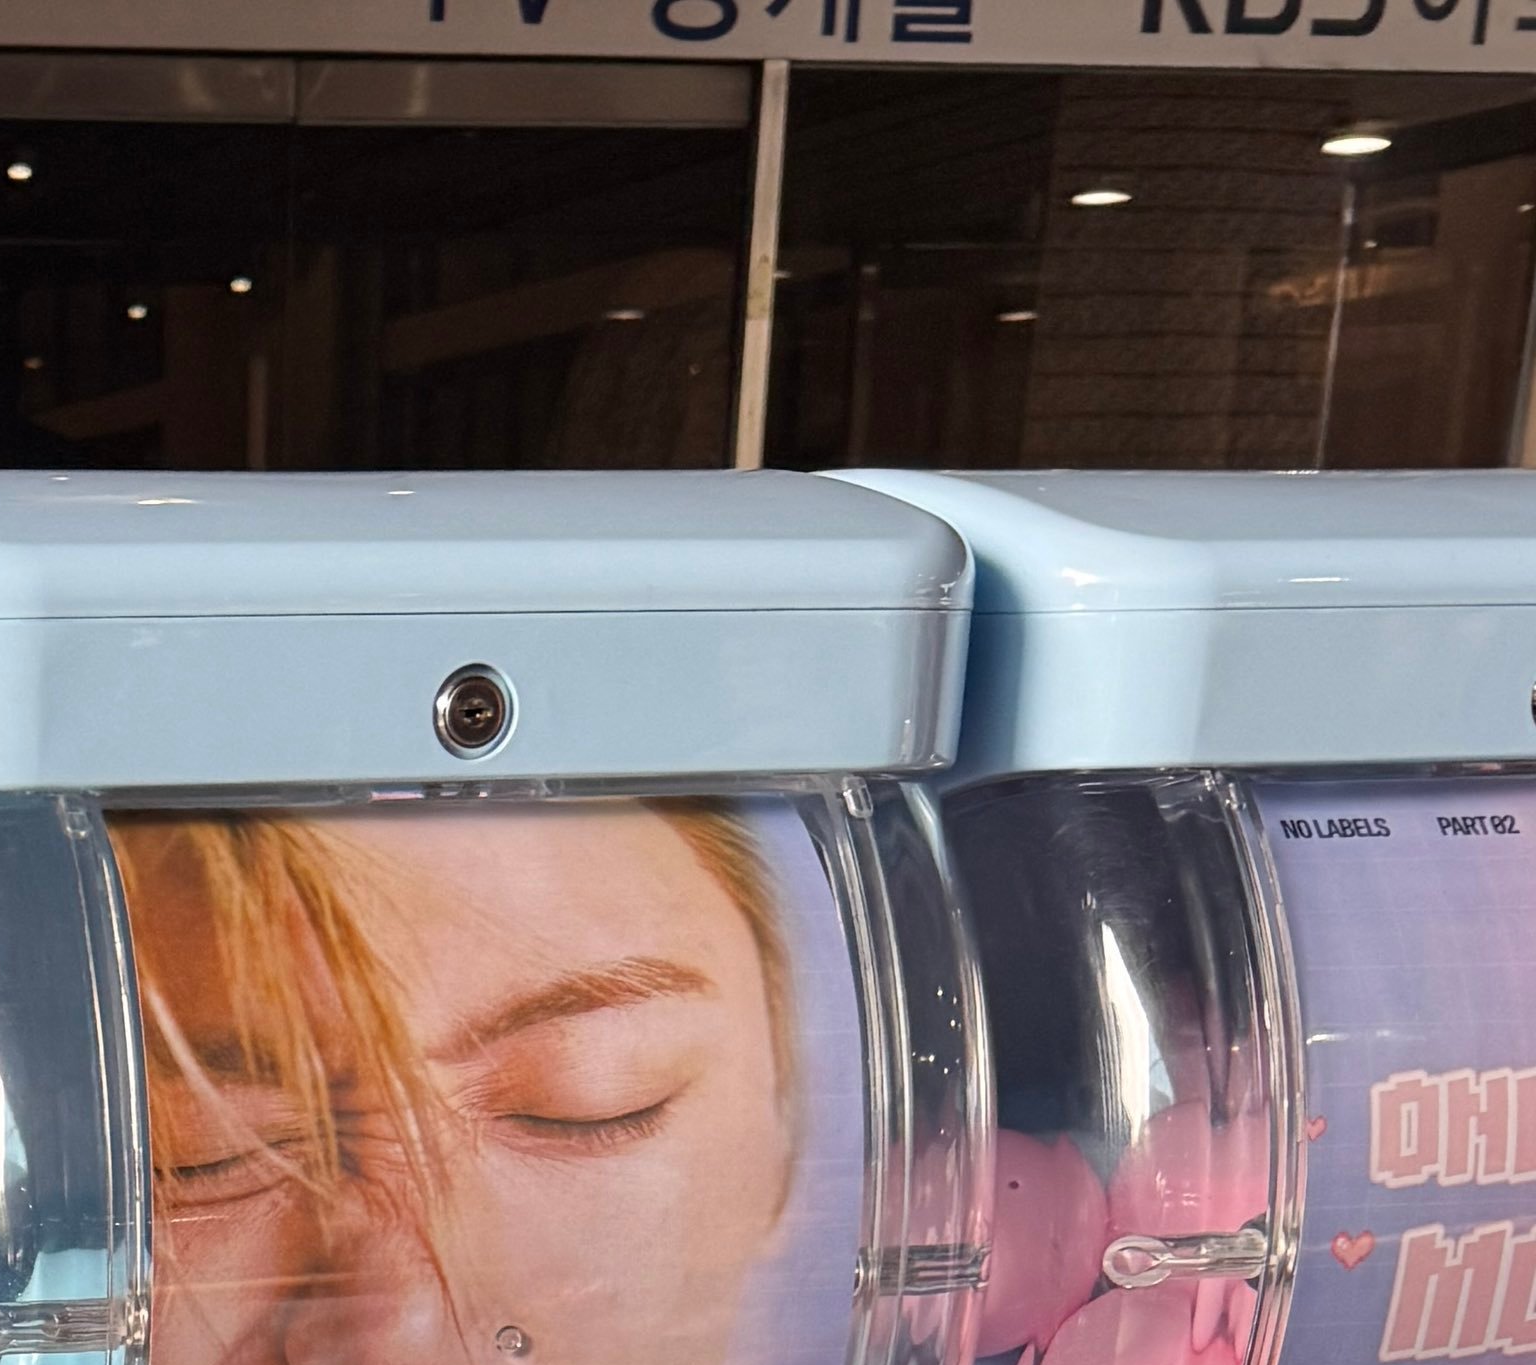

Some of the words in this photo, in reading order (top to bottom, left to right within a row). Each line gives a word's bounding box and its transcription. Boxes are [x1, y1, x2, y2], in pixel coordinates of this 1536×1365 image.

[1280, 819, 1312, 839] NO
[1313, 818, 1392, 838] LABELS
[1436, 816, 1488, 835] PART
